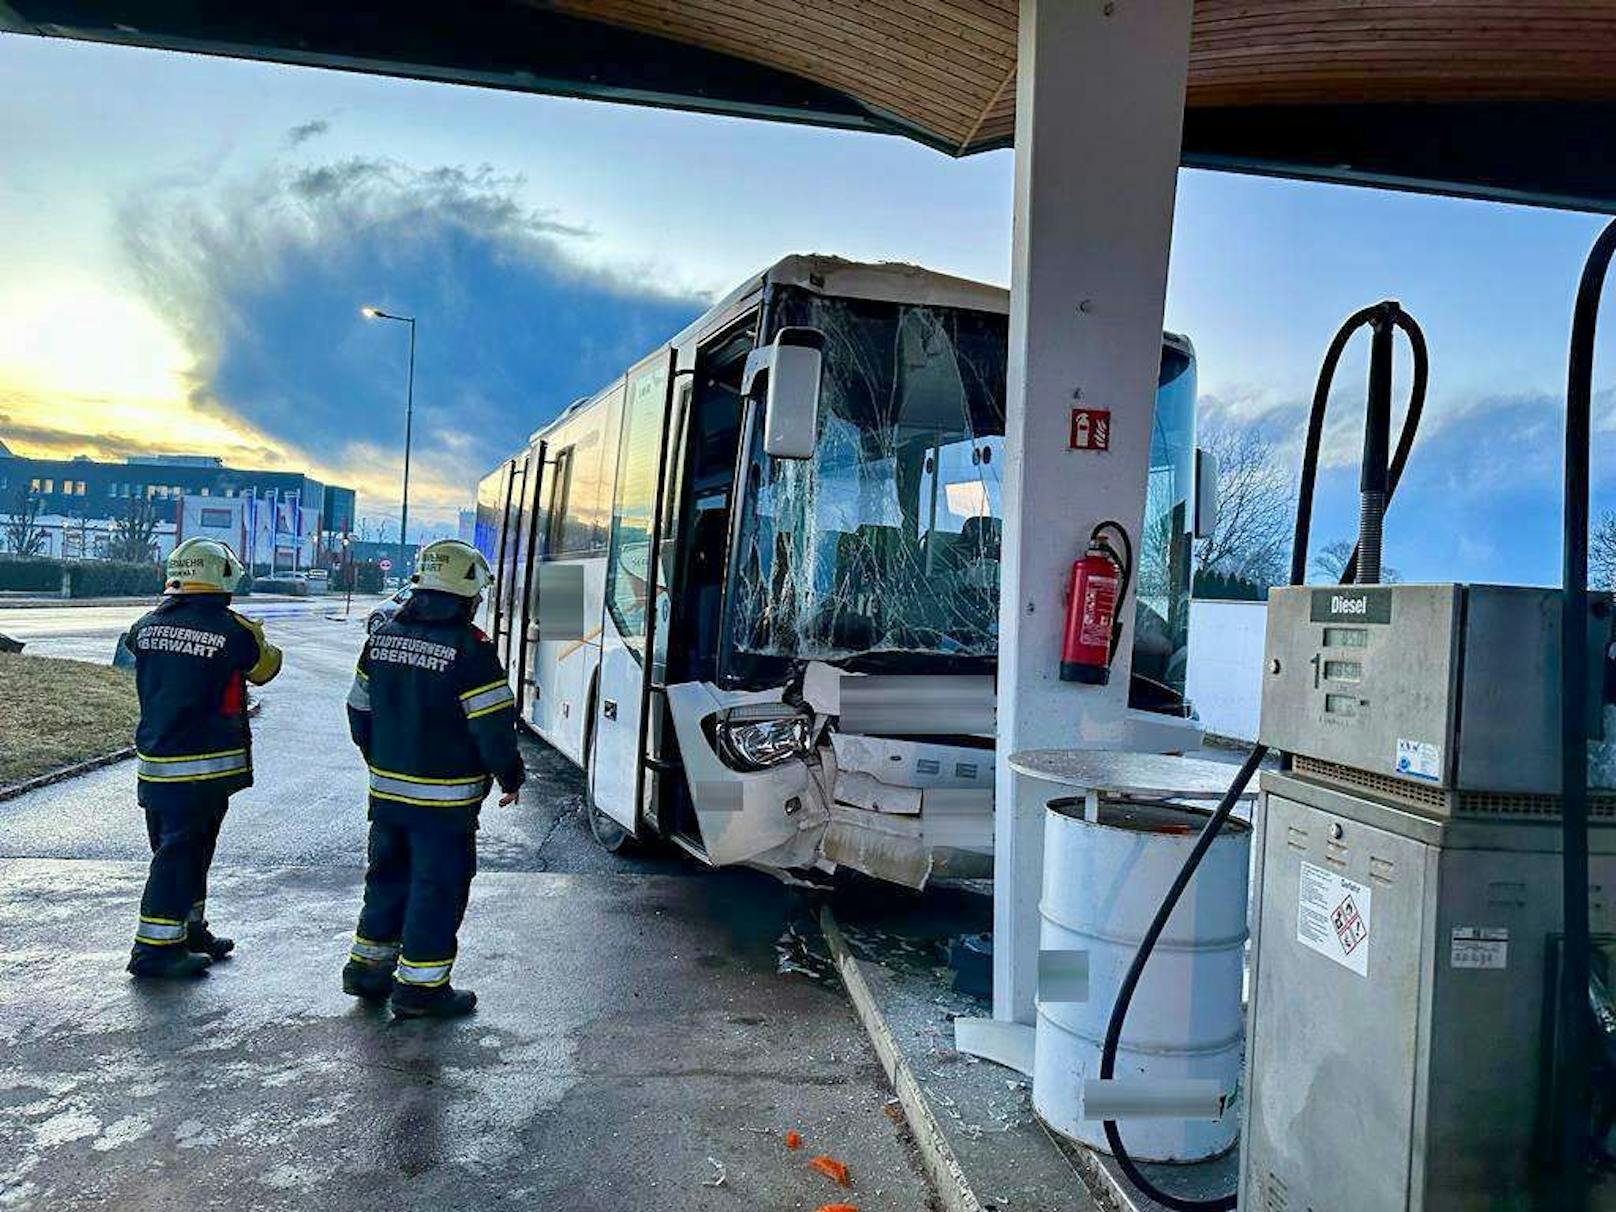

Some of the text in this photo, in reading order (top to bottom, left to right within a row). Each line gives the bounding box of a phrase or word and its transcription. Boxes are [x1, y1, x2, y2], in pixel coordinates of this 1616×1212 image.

[1331, 596, 1367, 614] Diesel
[137, 625, 226, 648] ADTFEUERWEHR
[370, 634, 457, 660] STADTFEUERWEHR
[370, 647, 449, 672] OBERWART
[917, 759, 994, 779] SE
